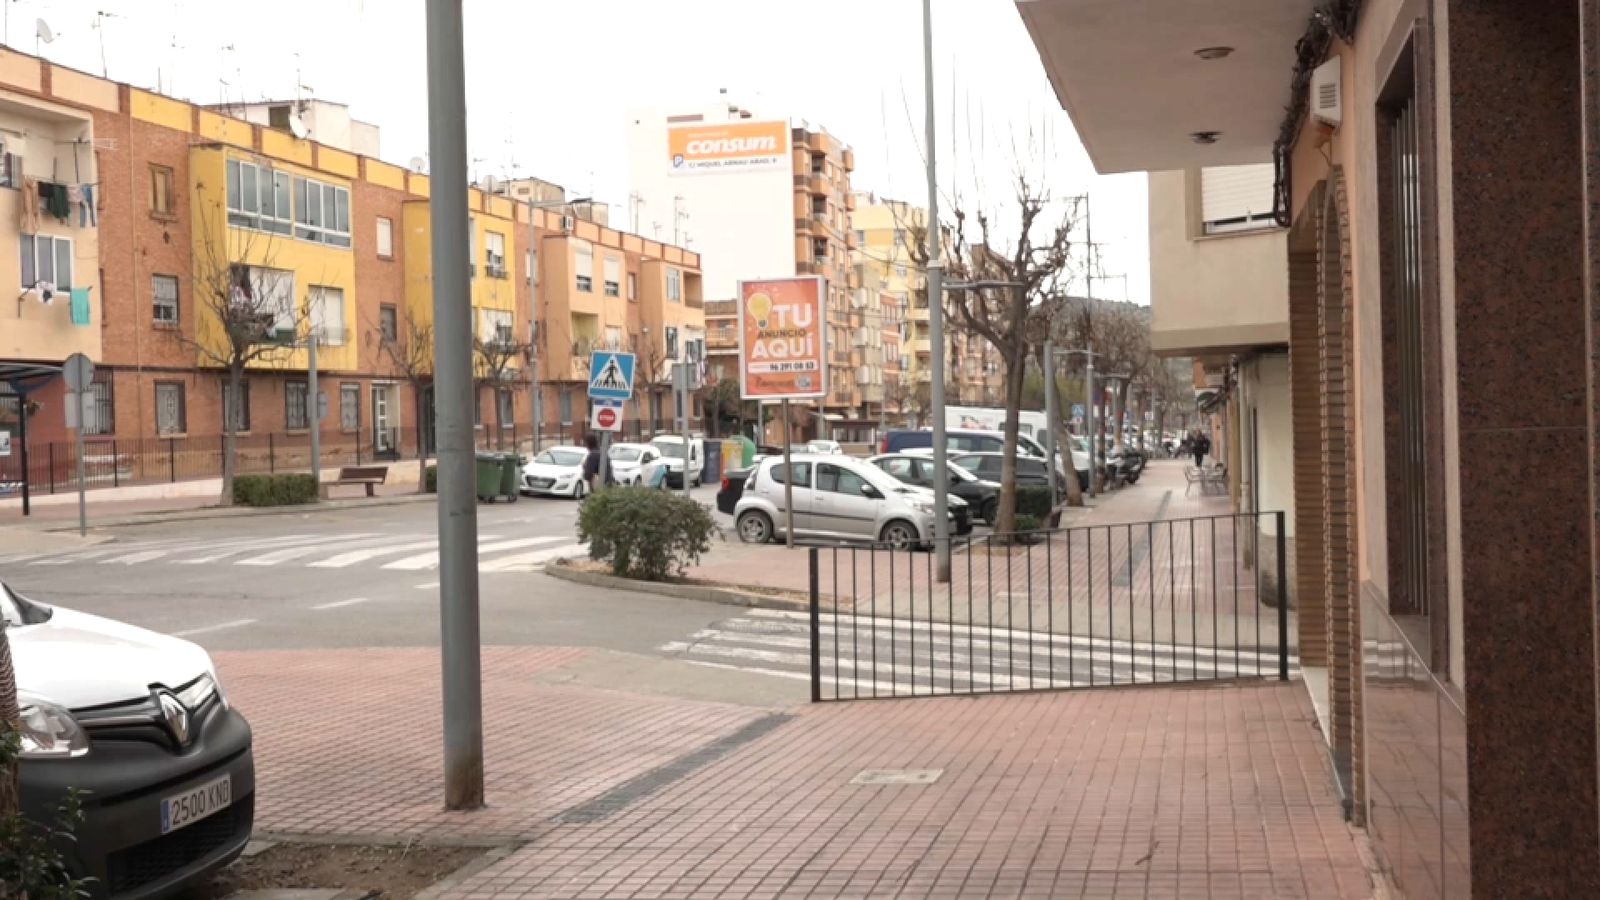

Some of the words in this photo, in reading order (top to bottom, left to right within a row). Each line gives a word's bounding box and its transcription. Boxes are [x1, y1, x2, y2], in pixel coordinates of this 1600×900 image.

[687, 137, 775, 155] consum
[772, 304, 813, 328] TU
[751, 333, 813, 359] AQUÍ
[758, 329, 806, 339] ANUNCIO
[172, 790, 206, 825] 2500
